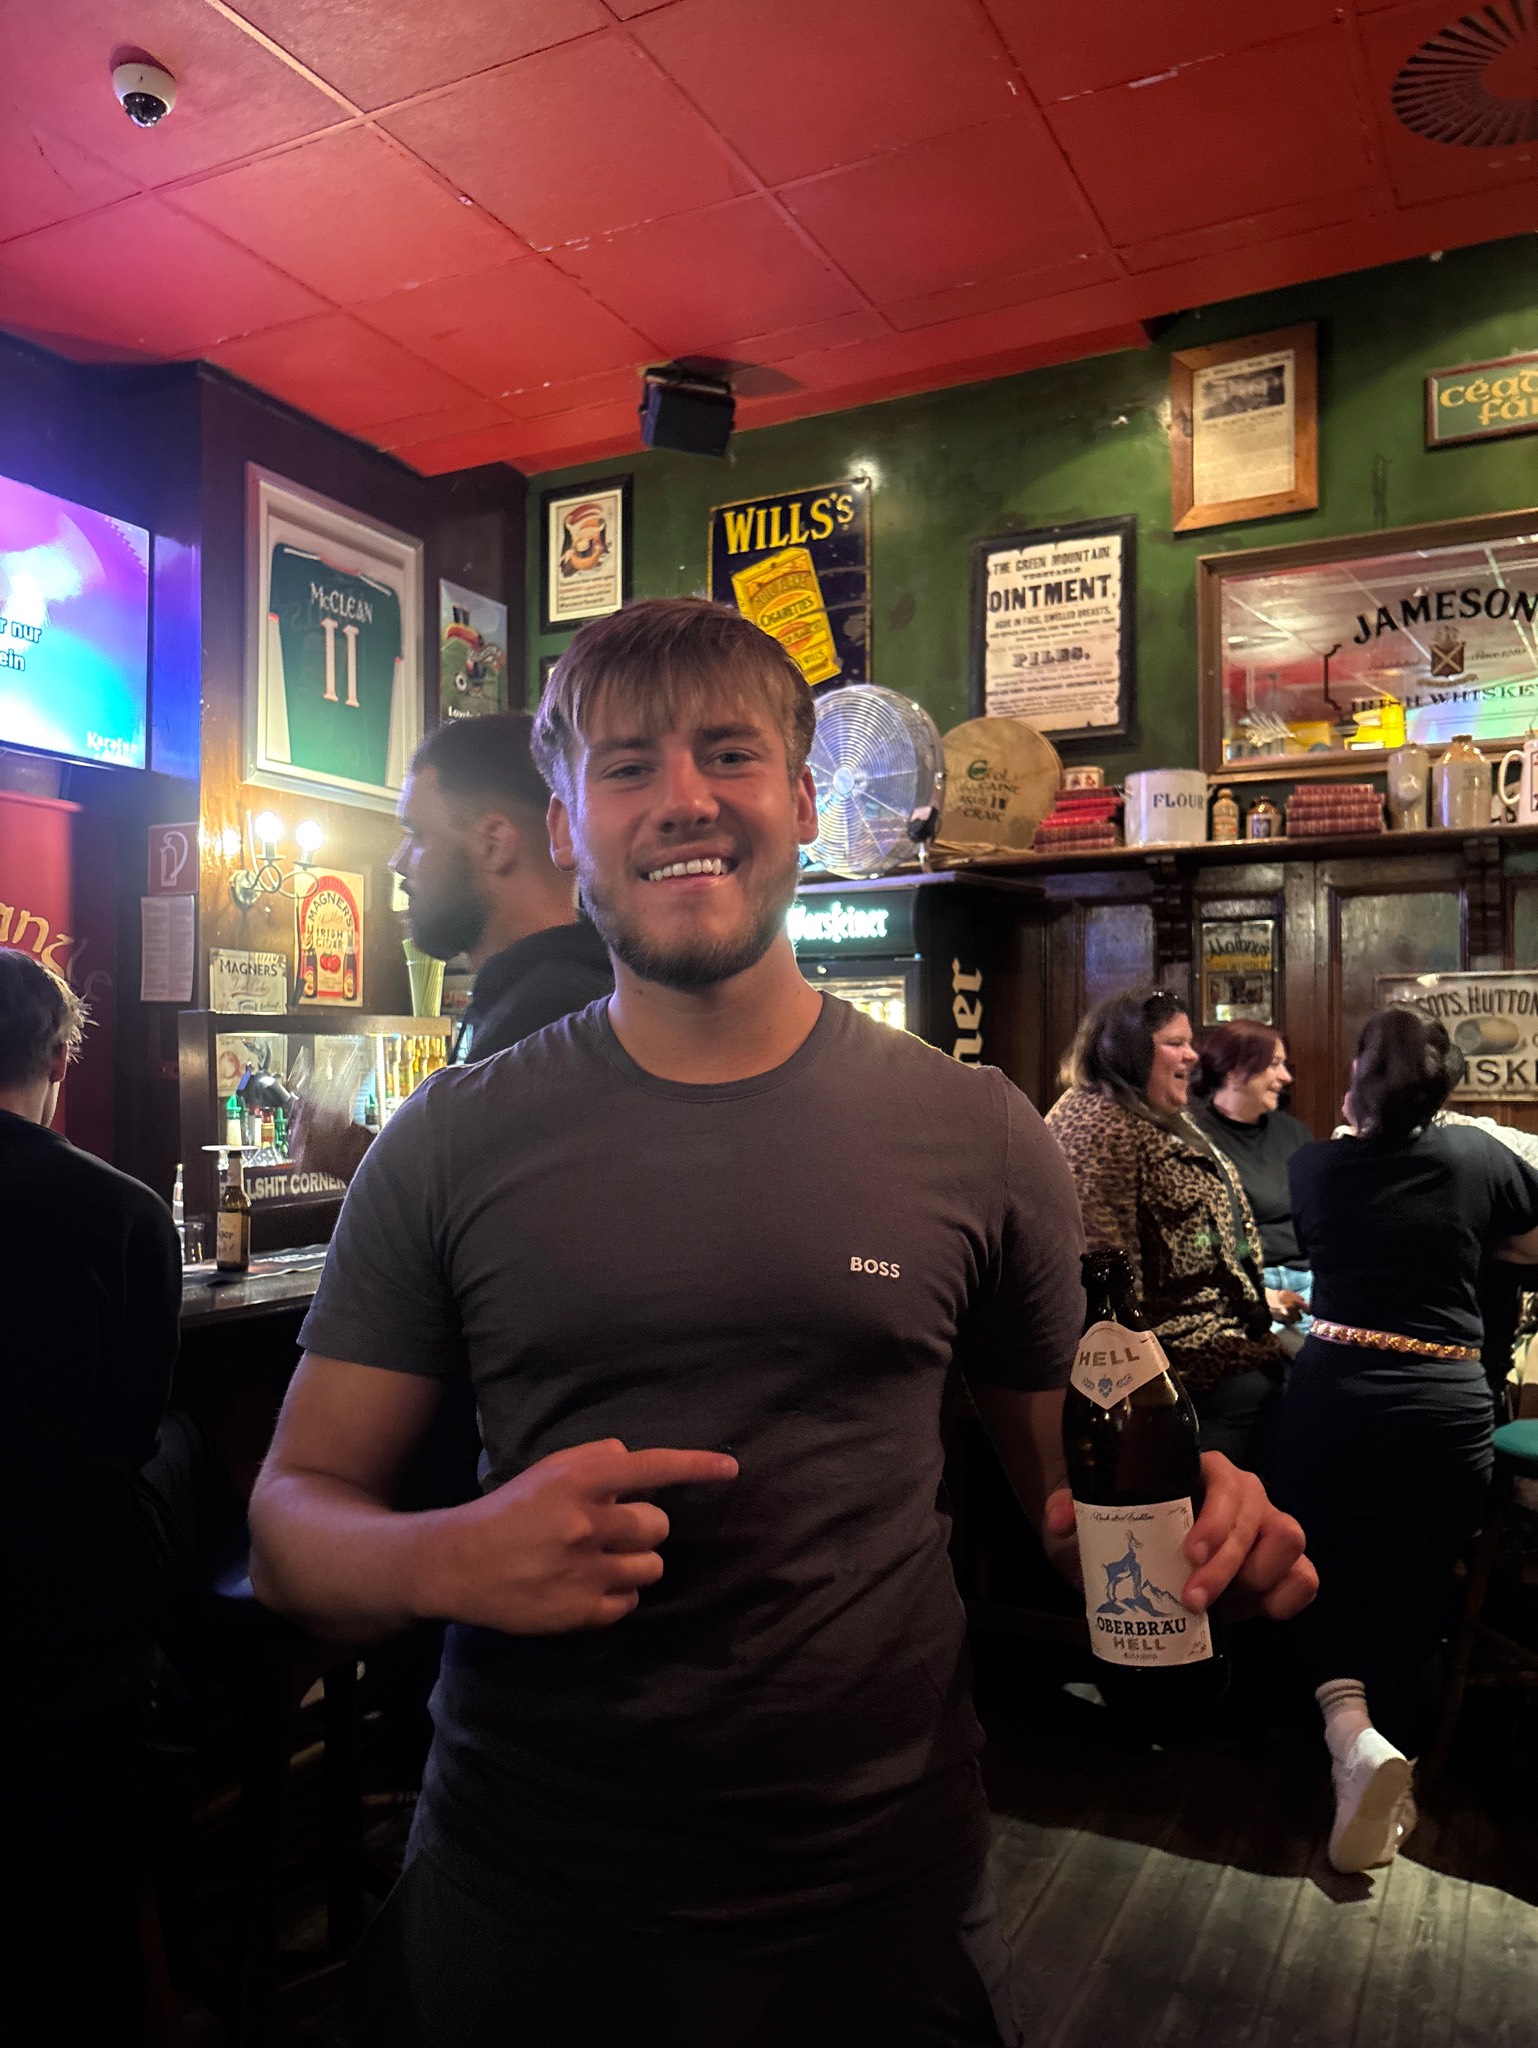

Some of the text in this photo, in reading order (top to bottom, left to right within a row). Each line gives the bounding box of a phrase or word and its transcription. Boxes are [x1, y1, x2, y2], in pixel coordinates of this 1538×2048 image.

[1016, 557, 1046, 572] GREEN
[1353, 588, 1538, 644] JAMESON
[11, 621, 42, 643] nur
[321, 618, 360, 708] 11
[1430, 683, 1538, 703] WHISKE
[1153, 792, 1204, 810] FLOUR
[850, 1256, 900, 1278] BOSS
[1080, 1347, 1140, 1366] HELL
[1097, 1616, 1186, 1636] OBERBRÄU
[1113, 1636, 1166, 1651] HELL
